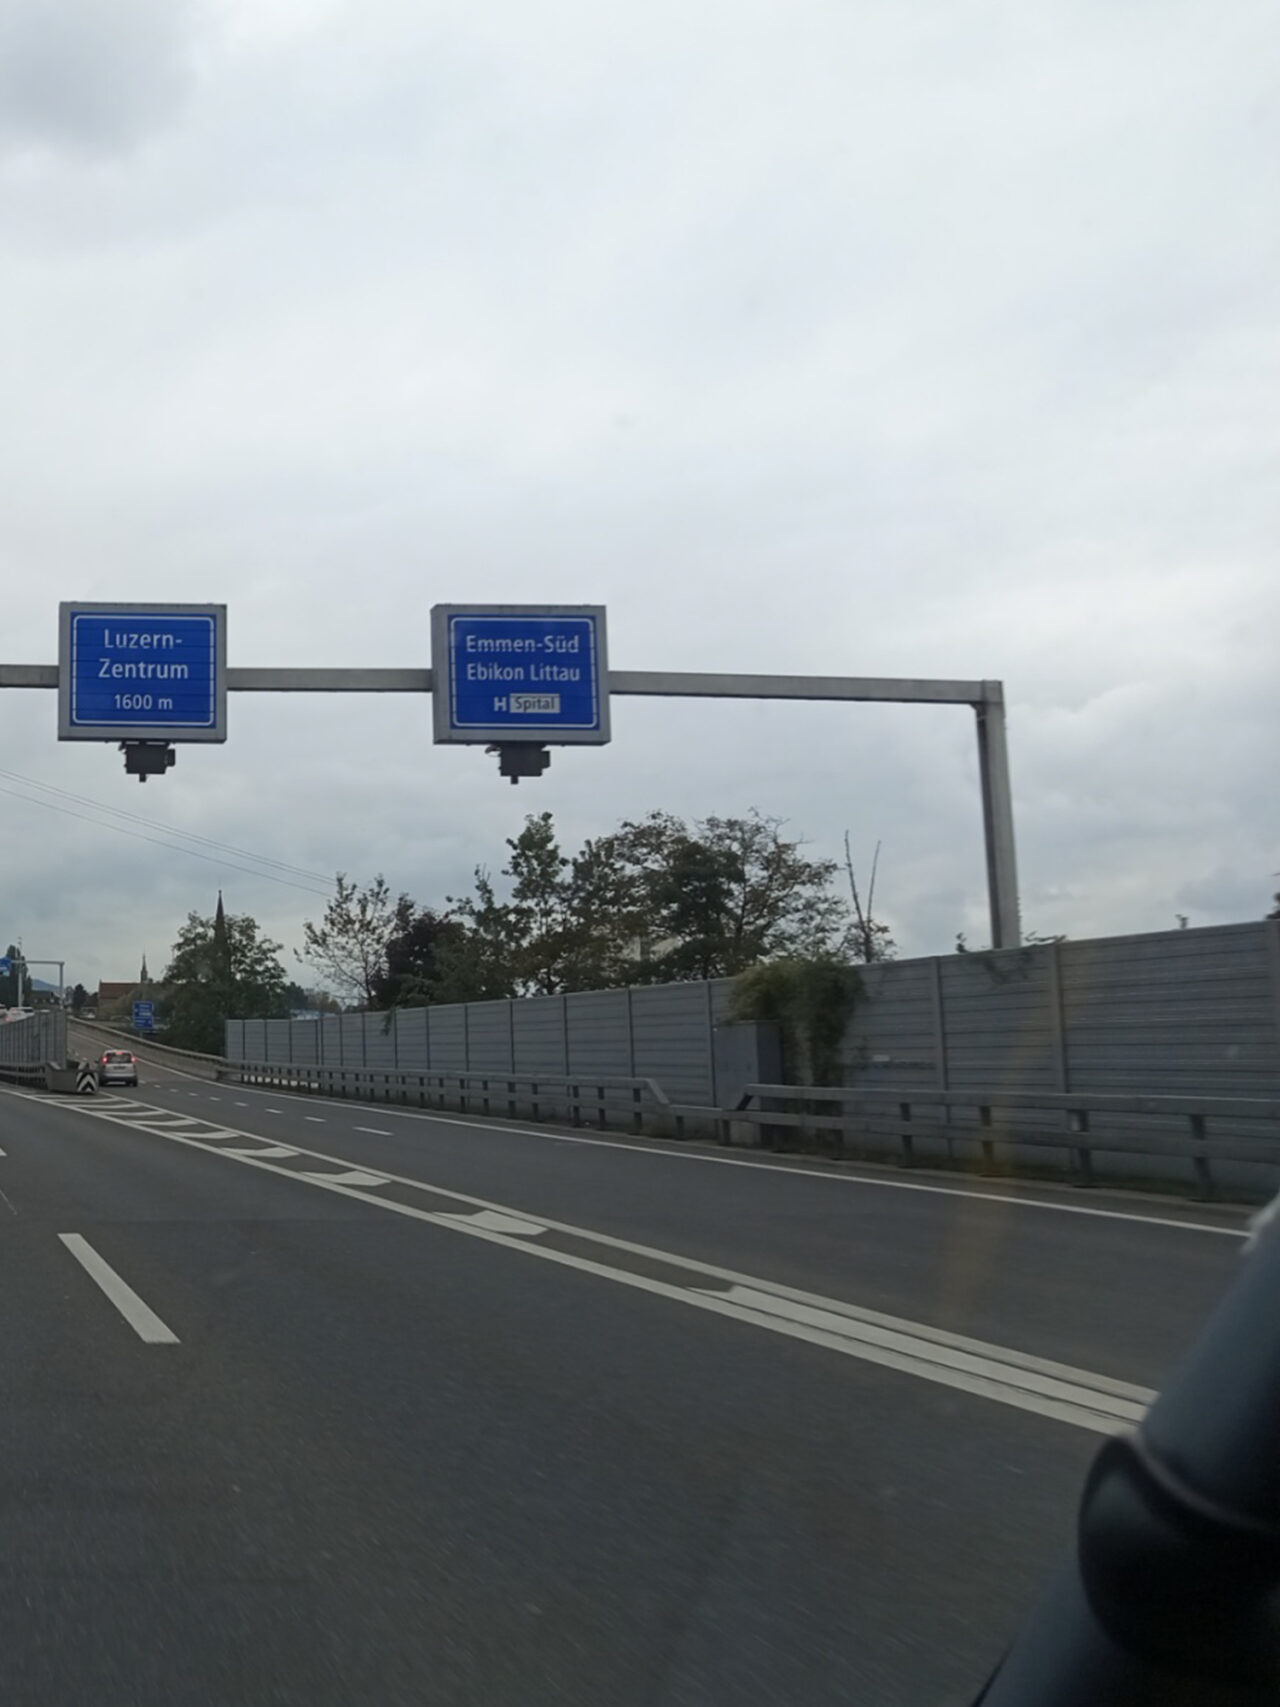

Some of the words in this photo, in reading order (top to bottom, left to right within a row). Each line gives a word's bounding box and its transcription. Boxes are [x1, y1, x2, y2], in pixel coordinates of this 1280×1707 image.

[104, 628, 183, 649] Luzern-
[465, 634, 580, 653] Emmen-Süd
[98, 658, 189, 679] Zentrum
[466, 662, 525, 681] Ebikon
[530, 663, 581, 681] Littau
[114, 694, 153, 710] 1600
[157, 698, 173, 710] m
[493, 696, 507, 711] H
[515, 695, 556, 712] Spital
